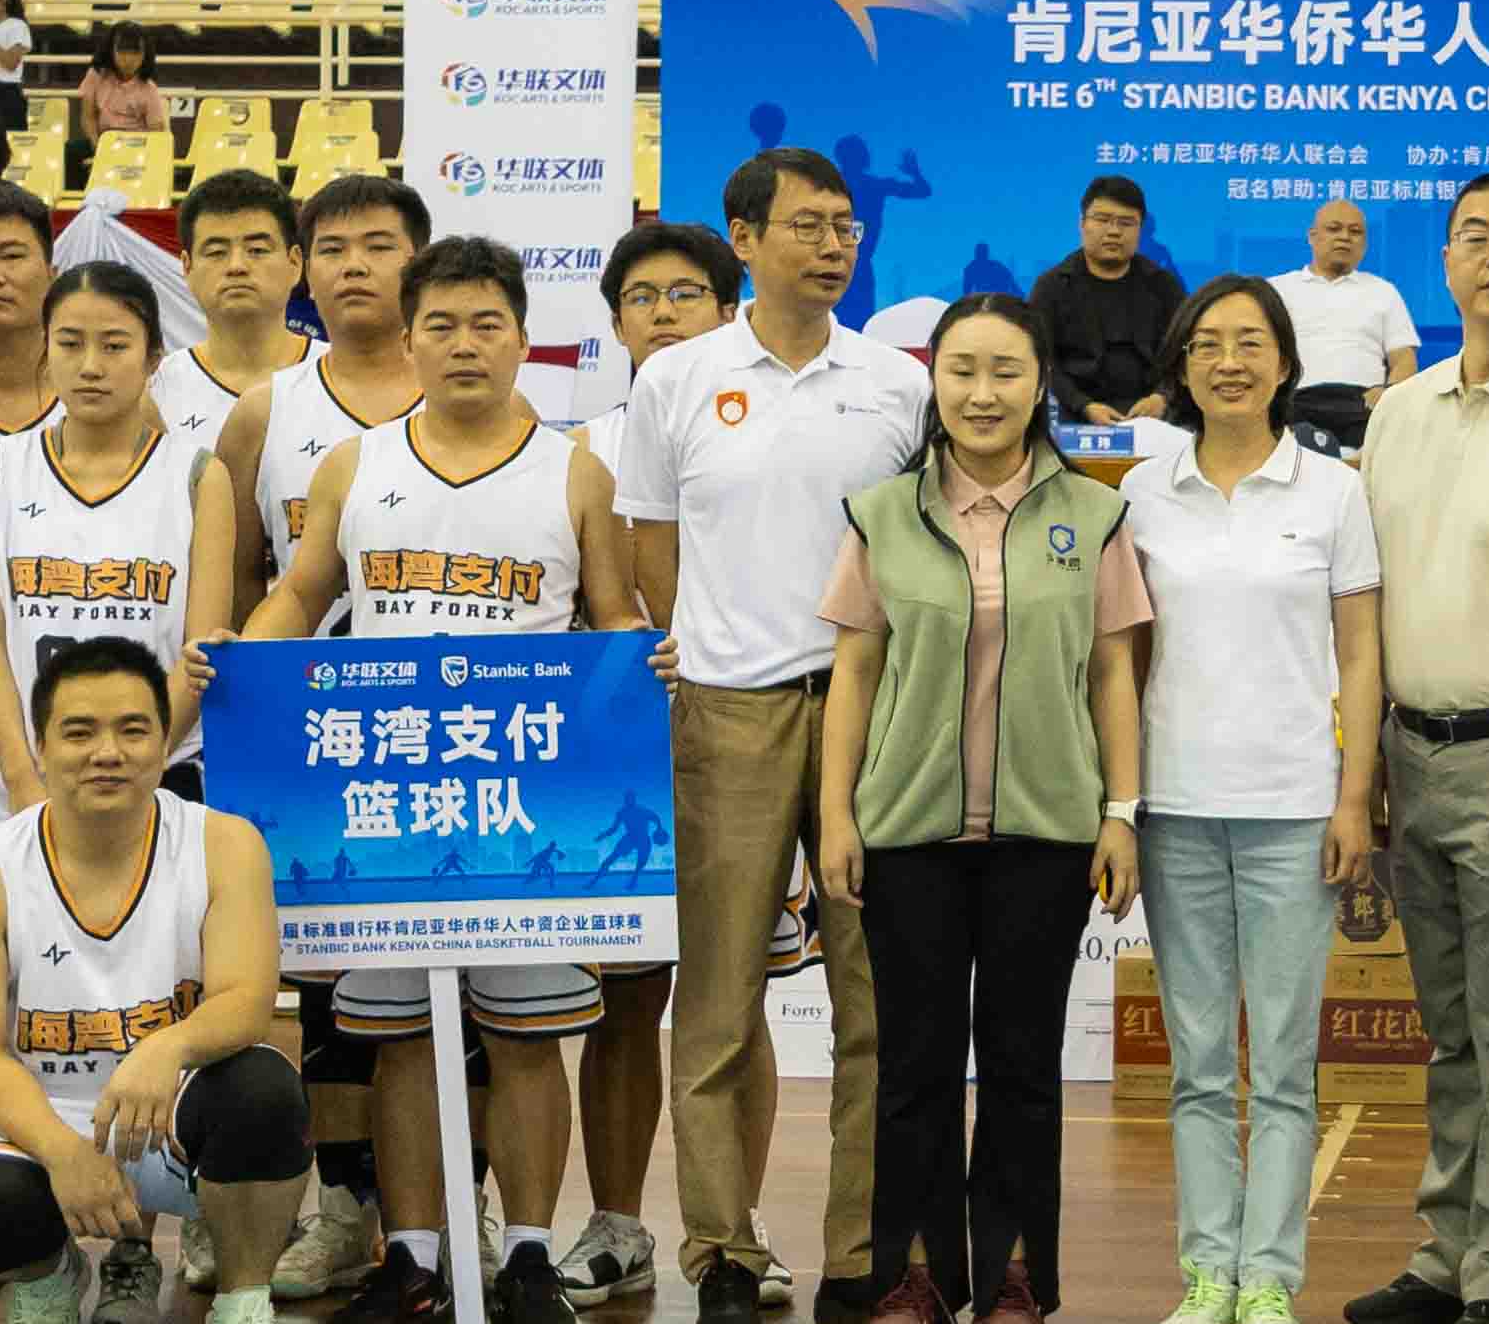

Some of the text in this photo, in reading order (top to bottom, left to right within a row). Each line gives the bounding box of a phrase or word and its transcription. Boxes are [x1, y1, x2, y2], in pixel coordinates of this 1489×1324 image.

[496, 68, 606, 91] 华联文体
[1007, 82, 1068, 108] THE
[1123, 82, 1257, 110] STANBIC
[1264, 83, 1350, 111] BANK
[1358, 84, 1451, 111] KENYA
[494, 157, 604, 180] 华联文体
[73, 606, 153, 621] FOREX
[375, 599, 516, 621] BAY FOREX
[341, 661, 418, 679] 华联文体
[472, 661, 572, 679] Stanbic Bank
[303, 701, 565, 768] 海湾支付
[341, 777, 536, 839] 篮球队
[296, 942, 350, 955] STANBIC
[352, 940, 387, 953] BANK
[389, 939, 431, 953] KENYA
[433, 938, 473, 951] CHINA
[475, 937, 554, 950] BASKETBALL
[558, 934, 643, 948] TOURNAMENT
[781, 1002, 824, 1021] Forty
[41, 1059, 98, 1075] BAY
